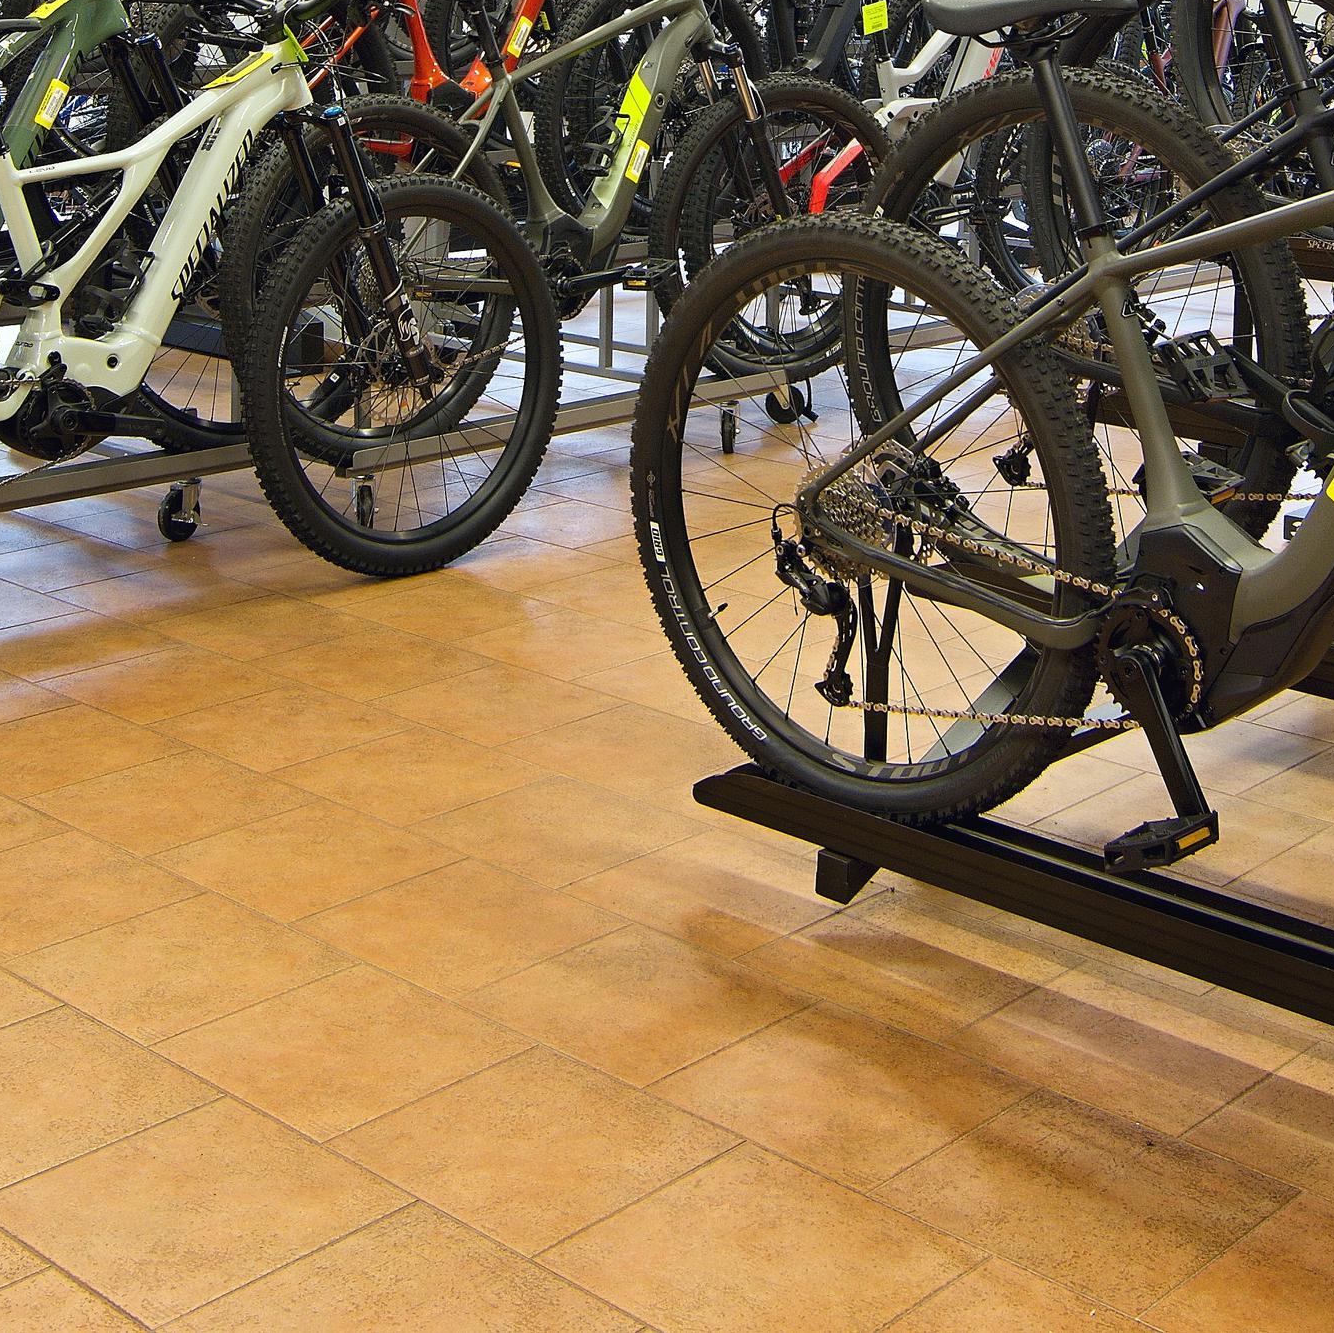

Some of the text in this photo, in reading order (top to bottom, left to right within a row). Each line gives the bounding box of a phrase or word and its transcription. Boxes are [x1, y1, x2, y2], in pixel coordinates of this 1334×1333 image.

[651, 526, 665, 558] GRID
[660, 566, 767, 742] GROUND CONTROL
